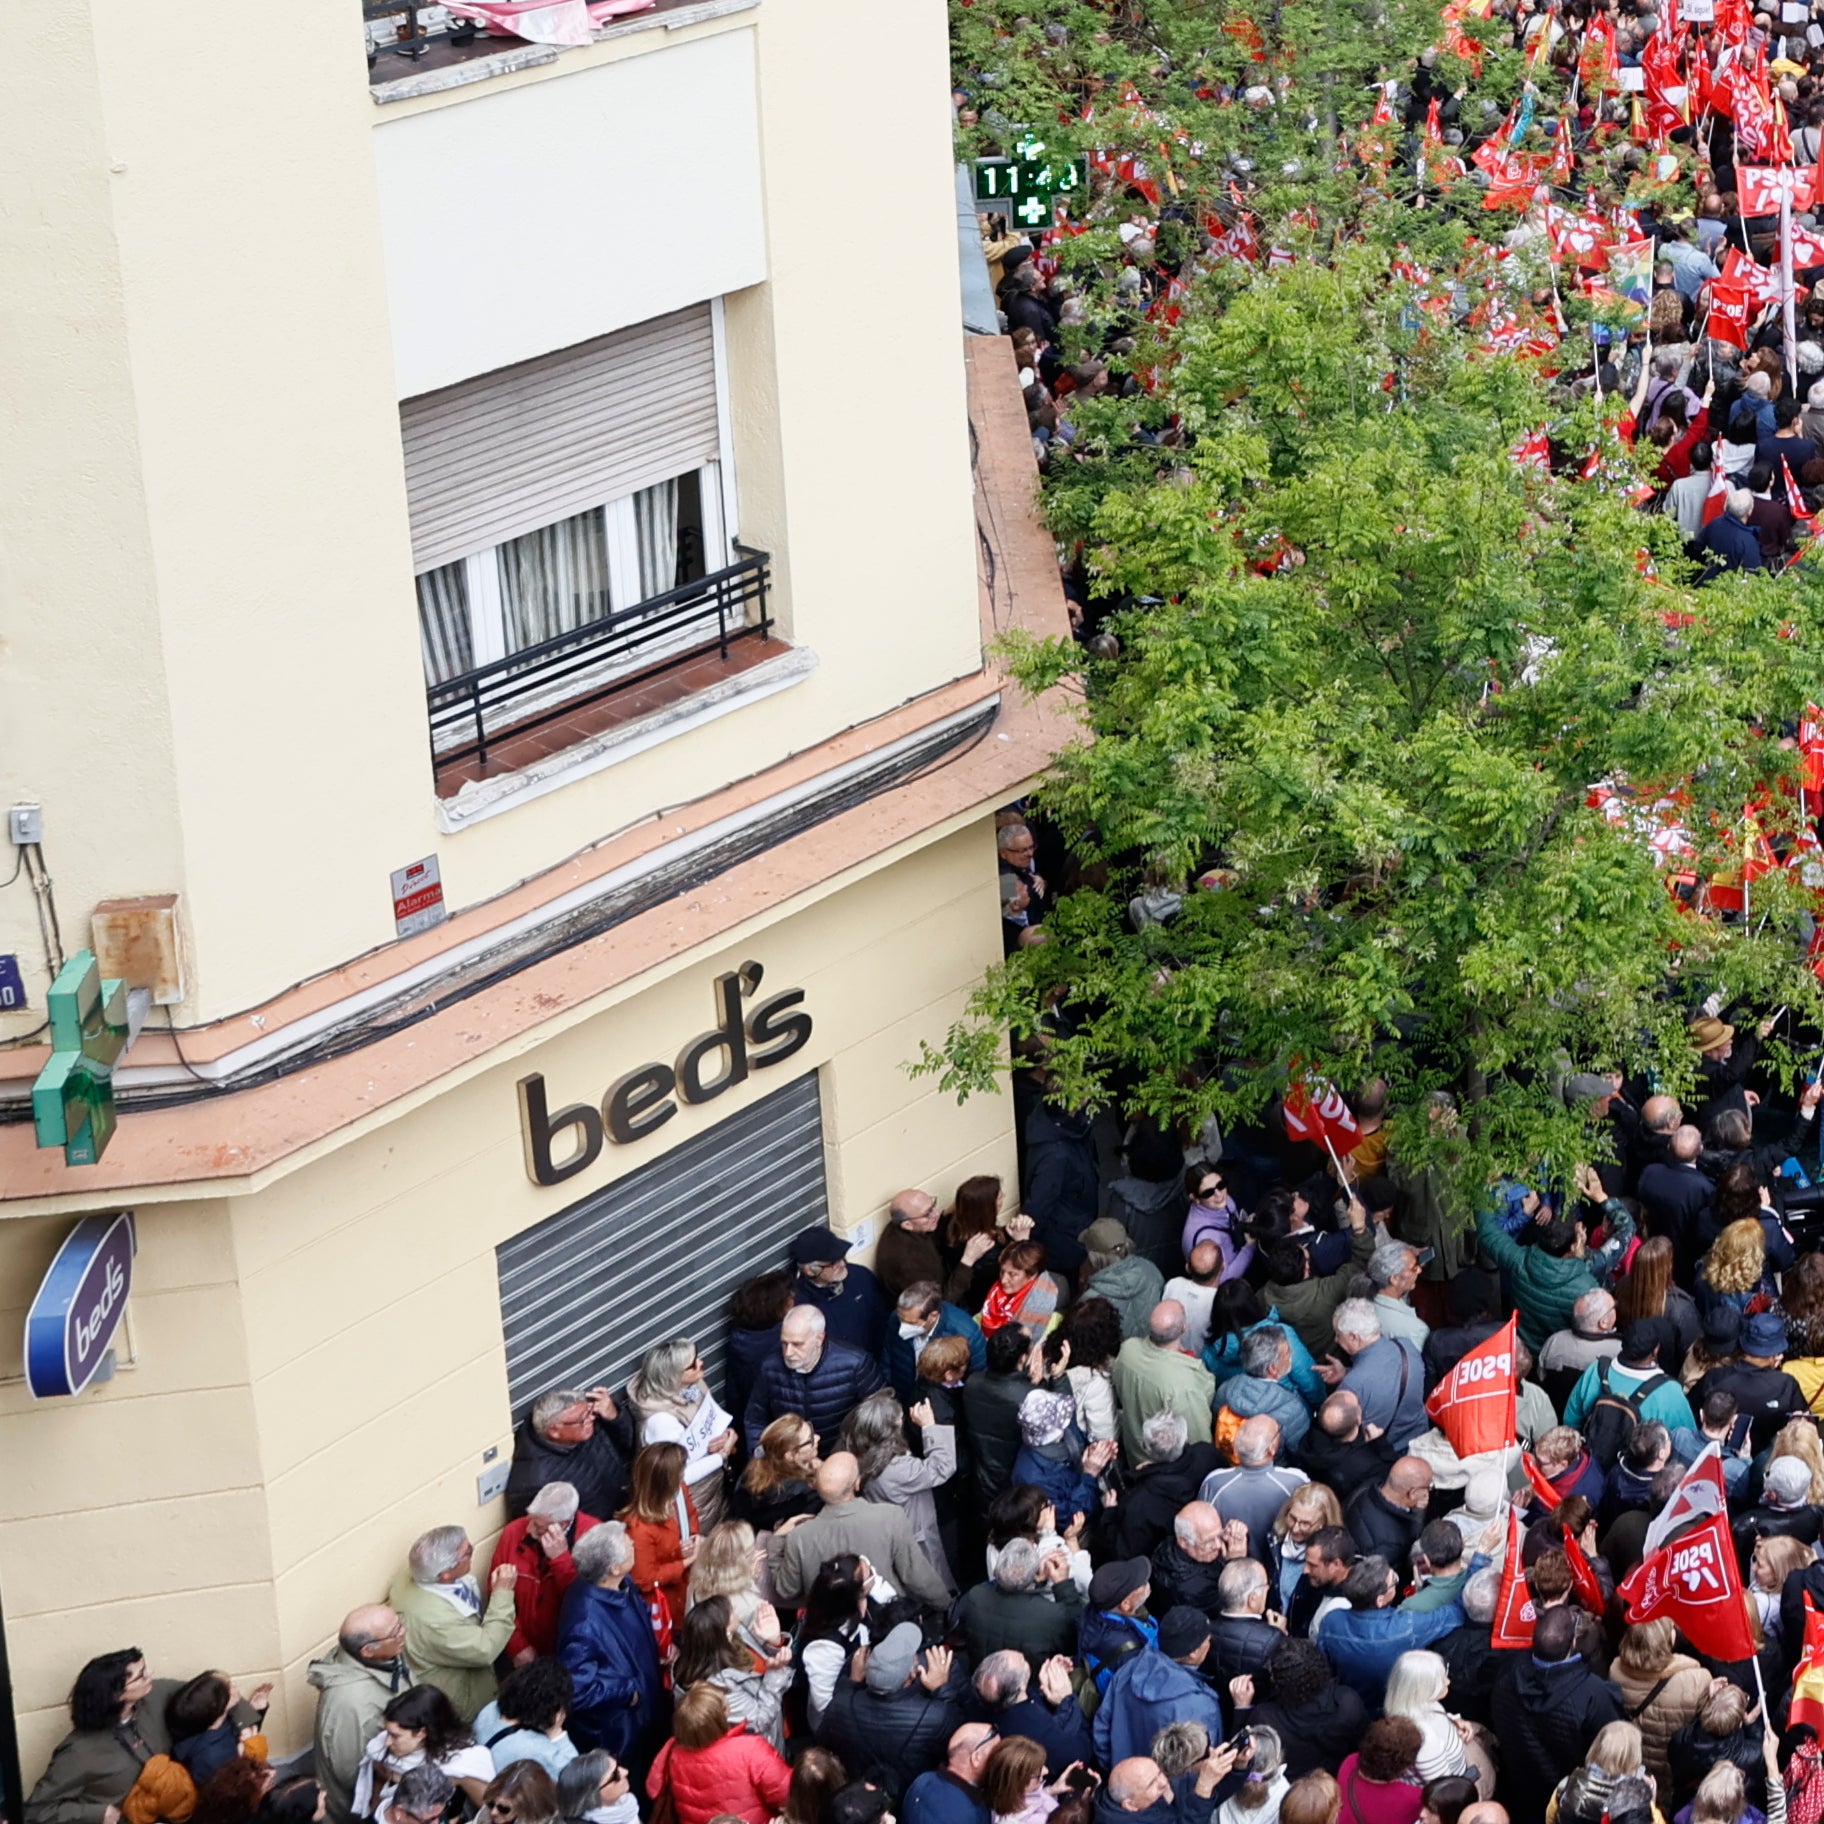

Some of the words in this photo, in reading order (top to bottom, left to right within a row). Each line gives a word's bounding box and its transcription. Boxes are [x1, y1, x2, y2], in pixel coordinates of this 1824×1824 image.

[398, 888, 444, 912] Alarma
[518, 960, 812, 1186] bed's
[75, 1255, 124, 1363] bed's
